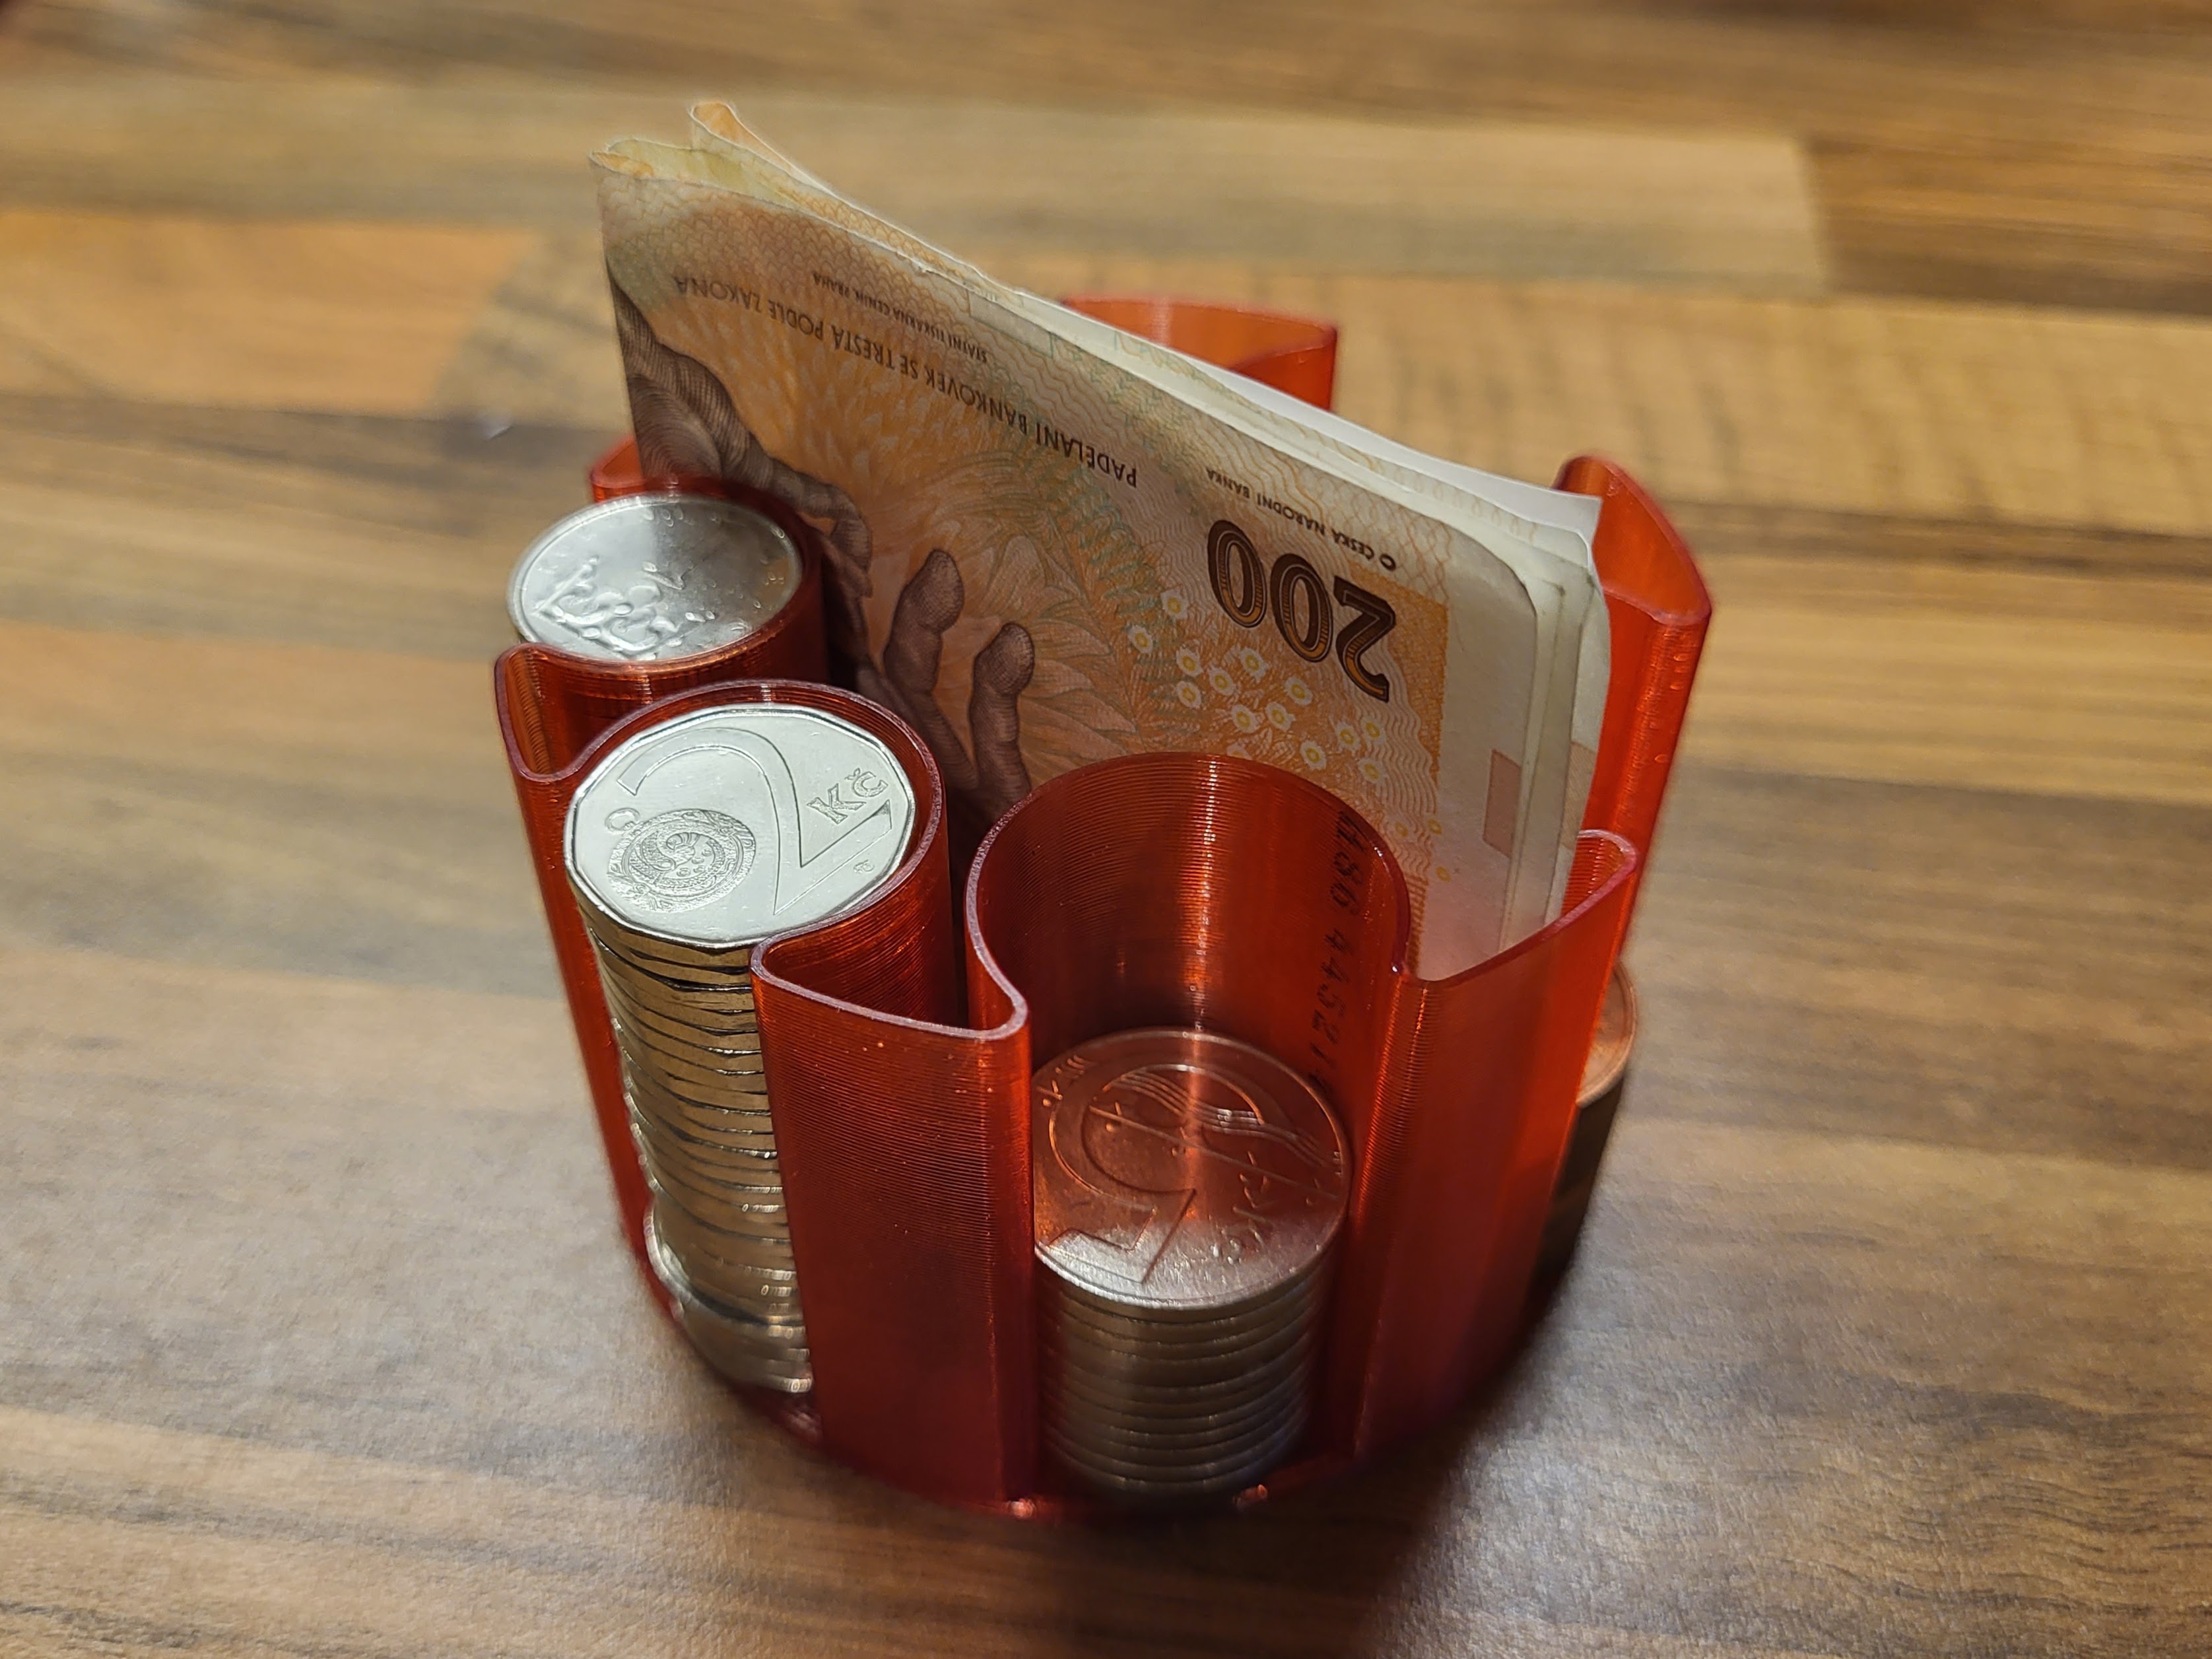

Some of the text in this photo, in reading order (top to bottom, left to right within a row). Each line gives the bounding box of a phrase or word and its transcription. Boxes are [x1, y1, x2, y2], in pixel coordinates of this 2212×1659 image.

[767, 299, 824, 341] PODLE
[899, 355, 918, 380] SE
[924, 364, 1027, 436] BANKOVEK
[1207, 520, 1396, 702] 200
[617, 726, 893, 916] 2
